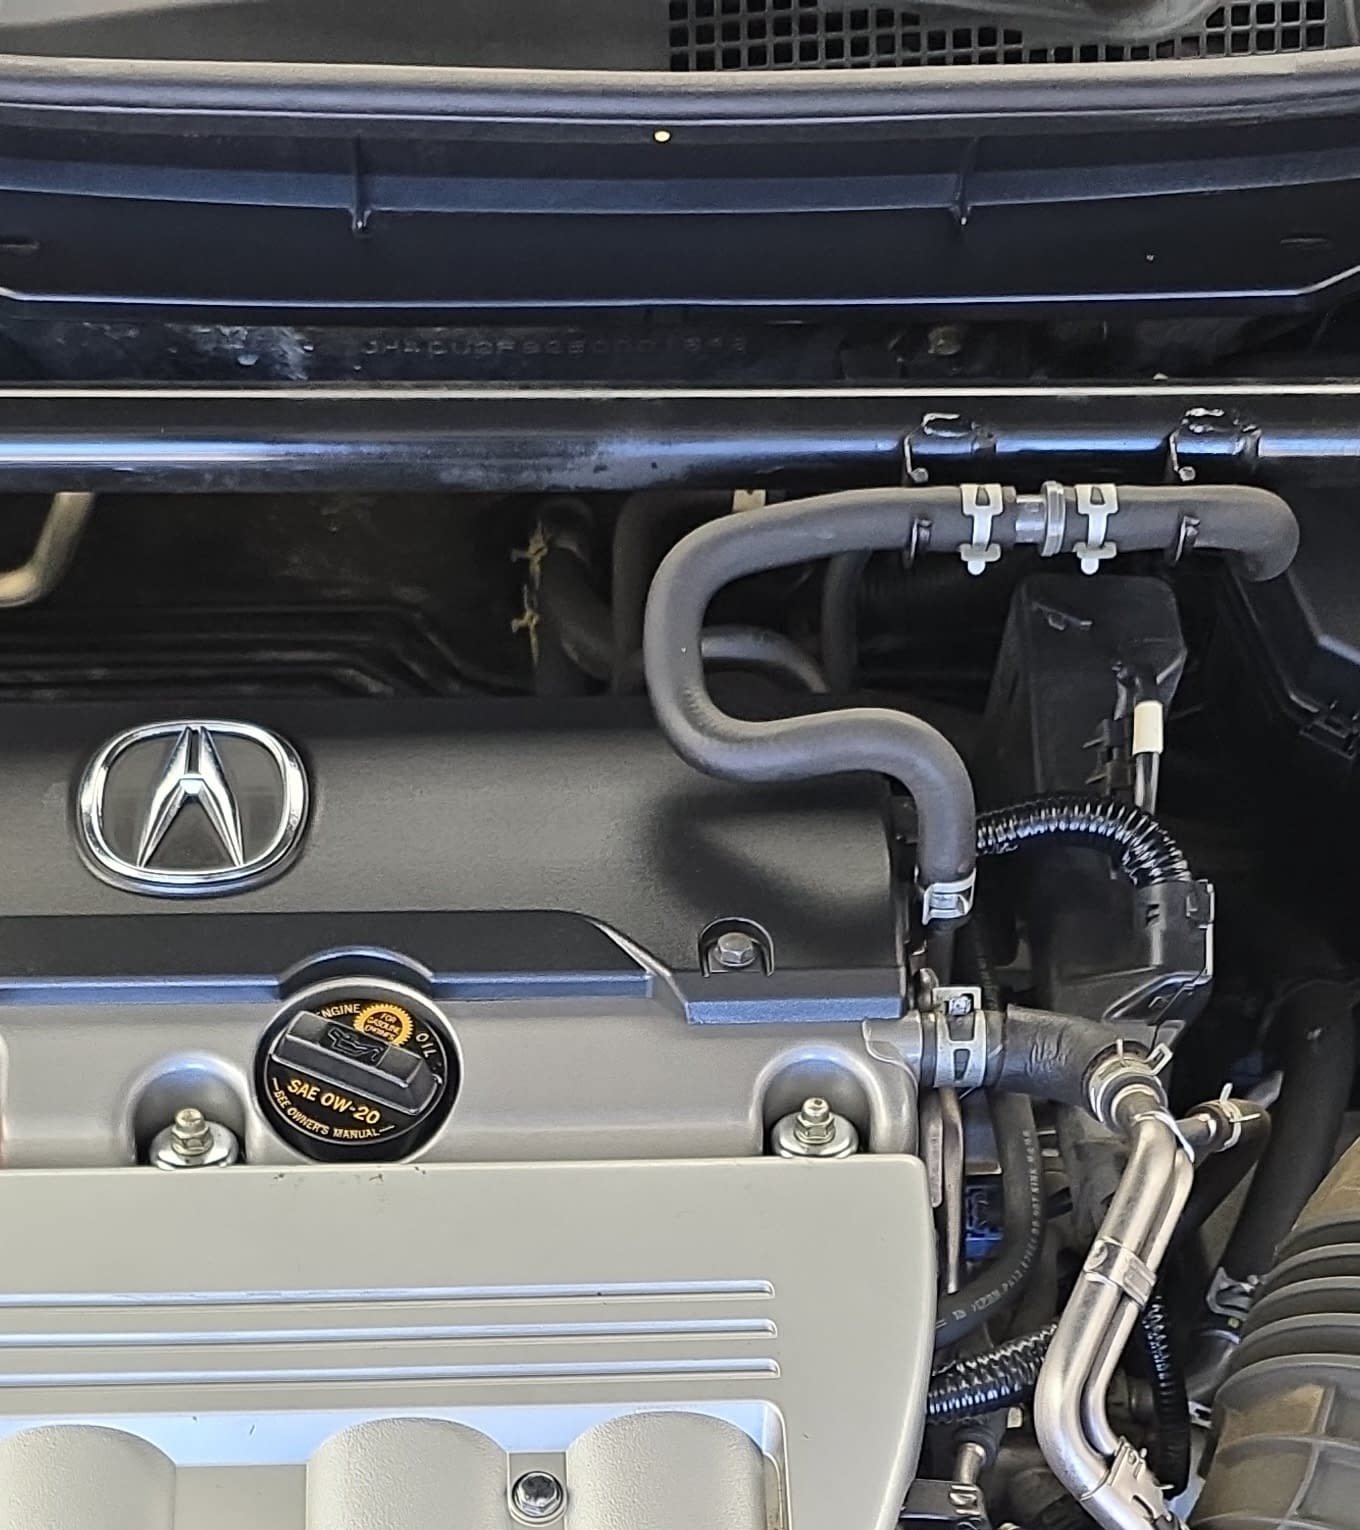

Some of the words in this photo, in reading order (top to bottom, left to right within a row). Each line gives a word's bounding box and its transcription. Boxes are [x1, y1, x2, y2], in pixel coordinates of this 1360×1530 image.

[316, 1004, 361, 1018] NGINE
[416, 1032, 438, 1058] OIL
[287, 1079, 322, 1101] SAE
[320, 1093, 381, 1125] 0W-20
[287, 1107, 330, 1135] OWNER'S
[332, 1127, 381, 1139] MANUAL
